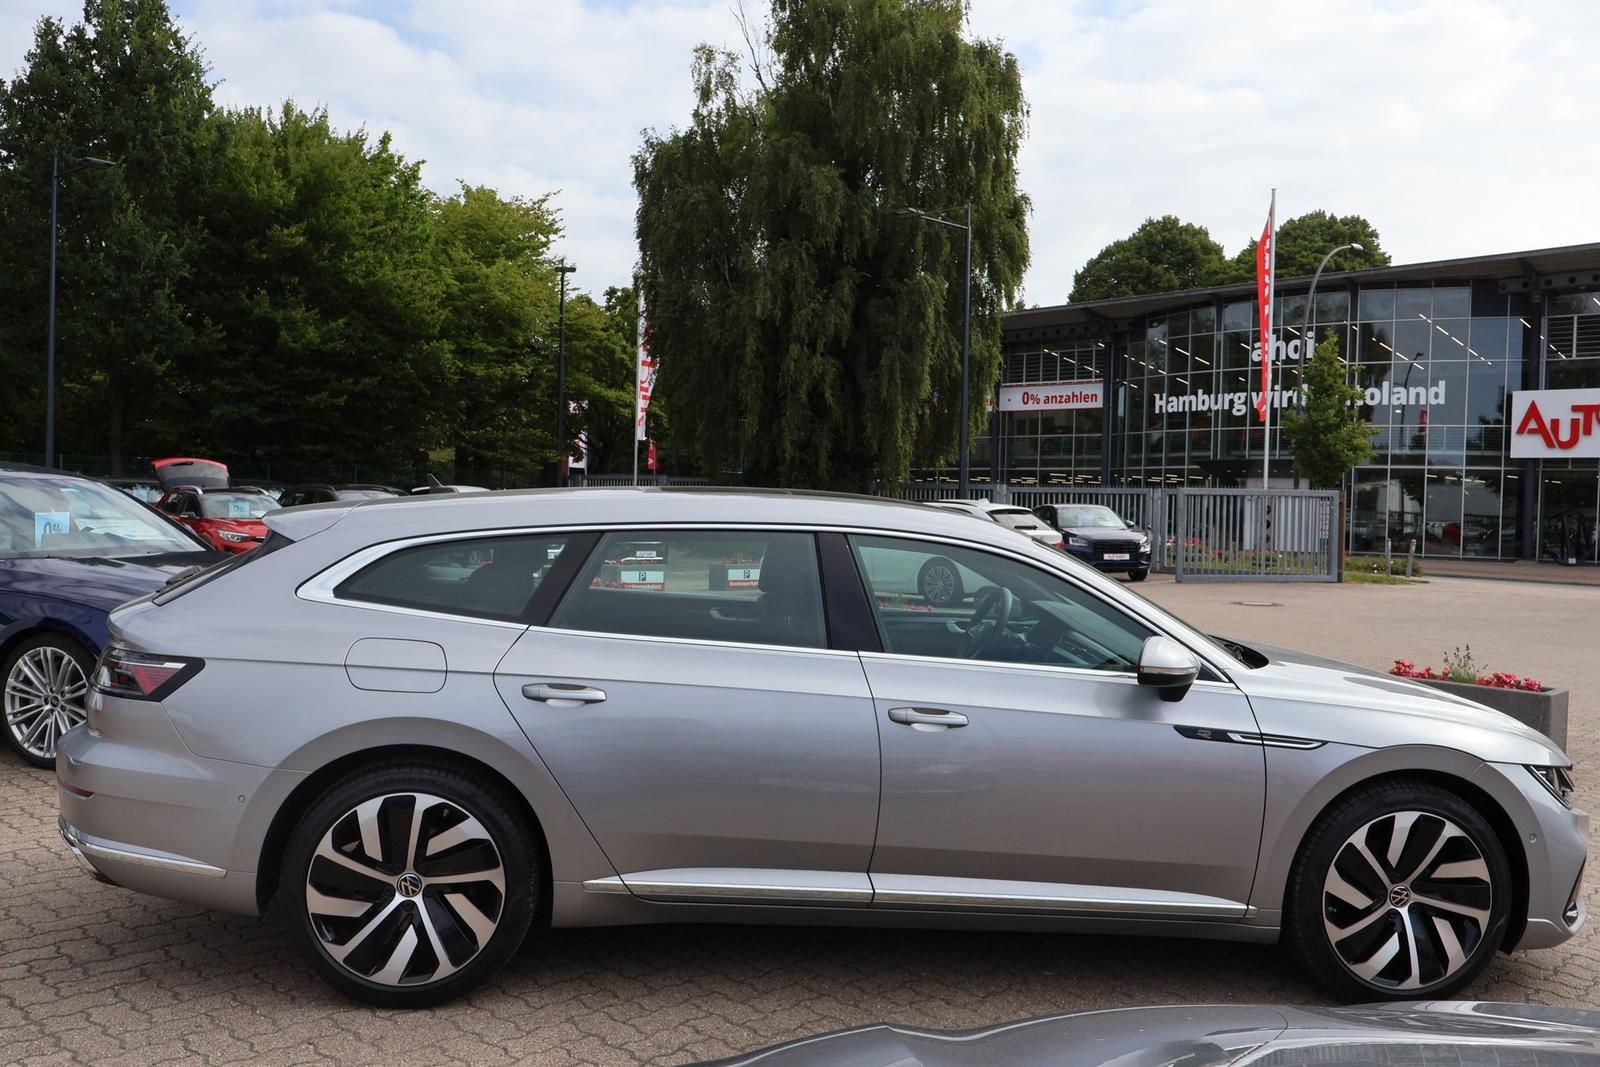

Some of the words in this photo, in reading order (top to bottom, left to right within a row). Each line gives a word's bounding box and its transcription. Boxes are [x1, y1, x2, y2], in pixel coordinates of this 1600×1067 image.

[1252, 331, 1315, 362] ahoi
[1022, 391, 1041, 405] 0%
[1043, 391, 1098, 405] anzahlen
[1153, 389, 1247, 416] Hamburg
[1516, 399, 1600, 449] AUT
